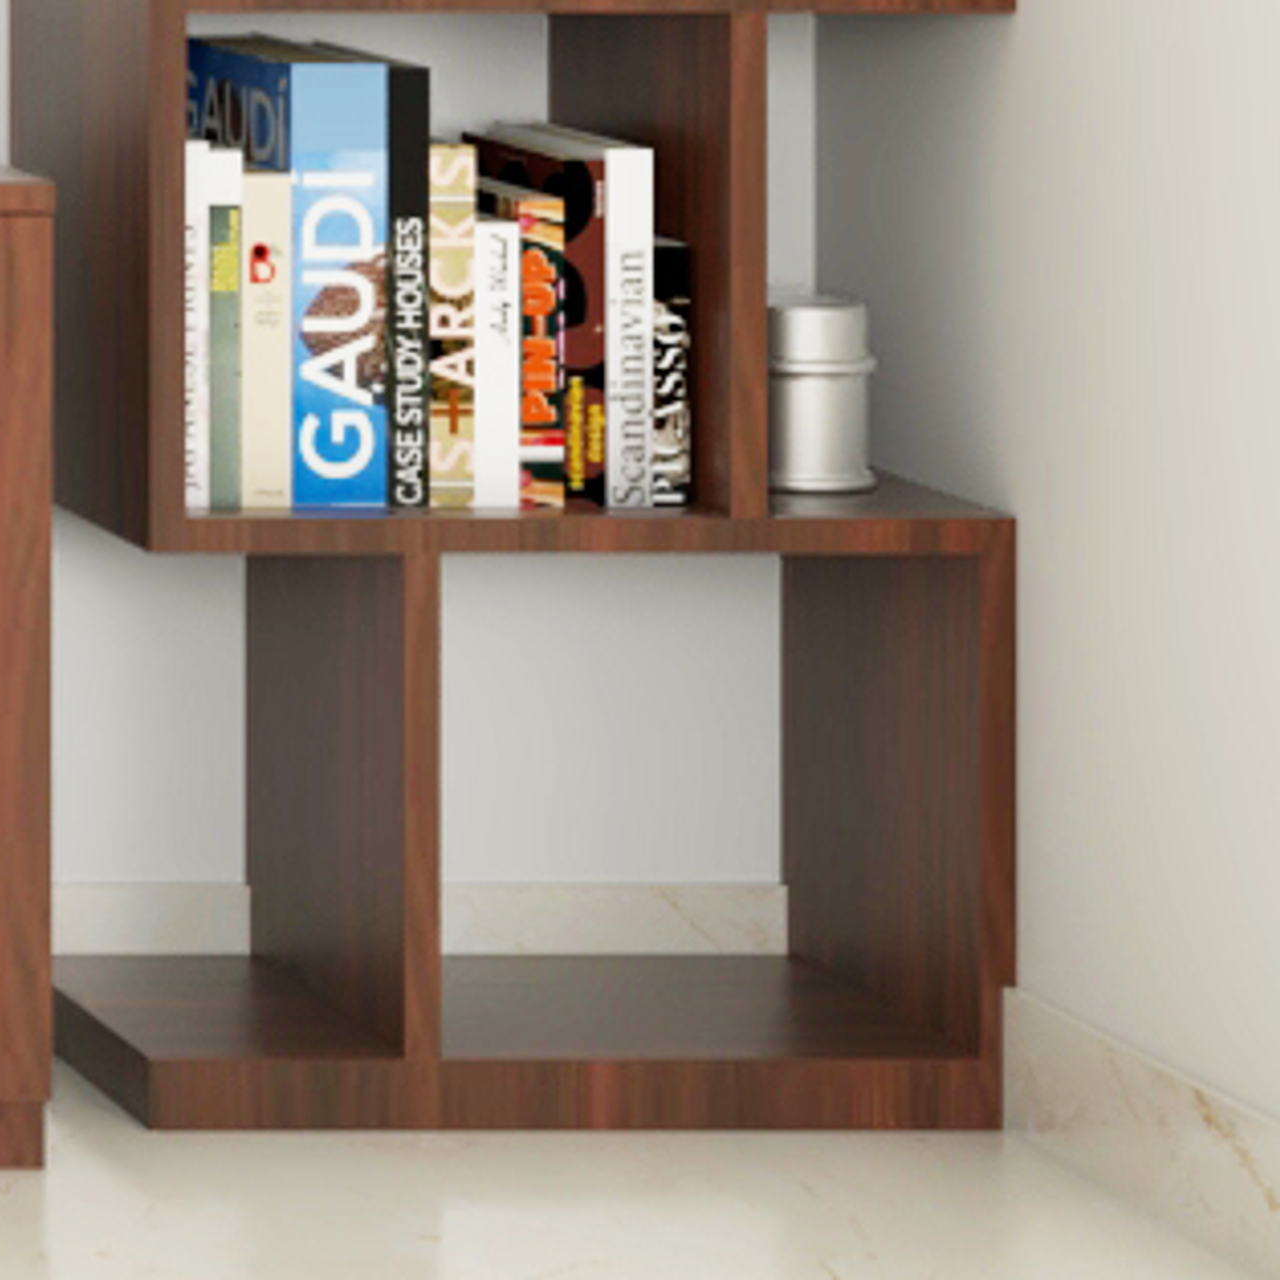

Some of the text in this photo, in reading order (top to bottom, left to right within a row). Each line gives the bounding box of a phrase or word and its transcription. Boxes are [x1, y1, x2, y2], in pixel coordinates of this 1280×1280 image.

[396, 216, 423, 504] CASE STUDY HOUSES
[522, 248, 557, 424] PIN-UP
[612, 249, 646, 506] Scandinavian
[652, 313, 685, 503] PICASSO
